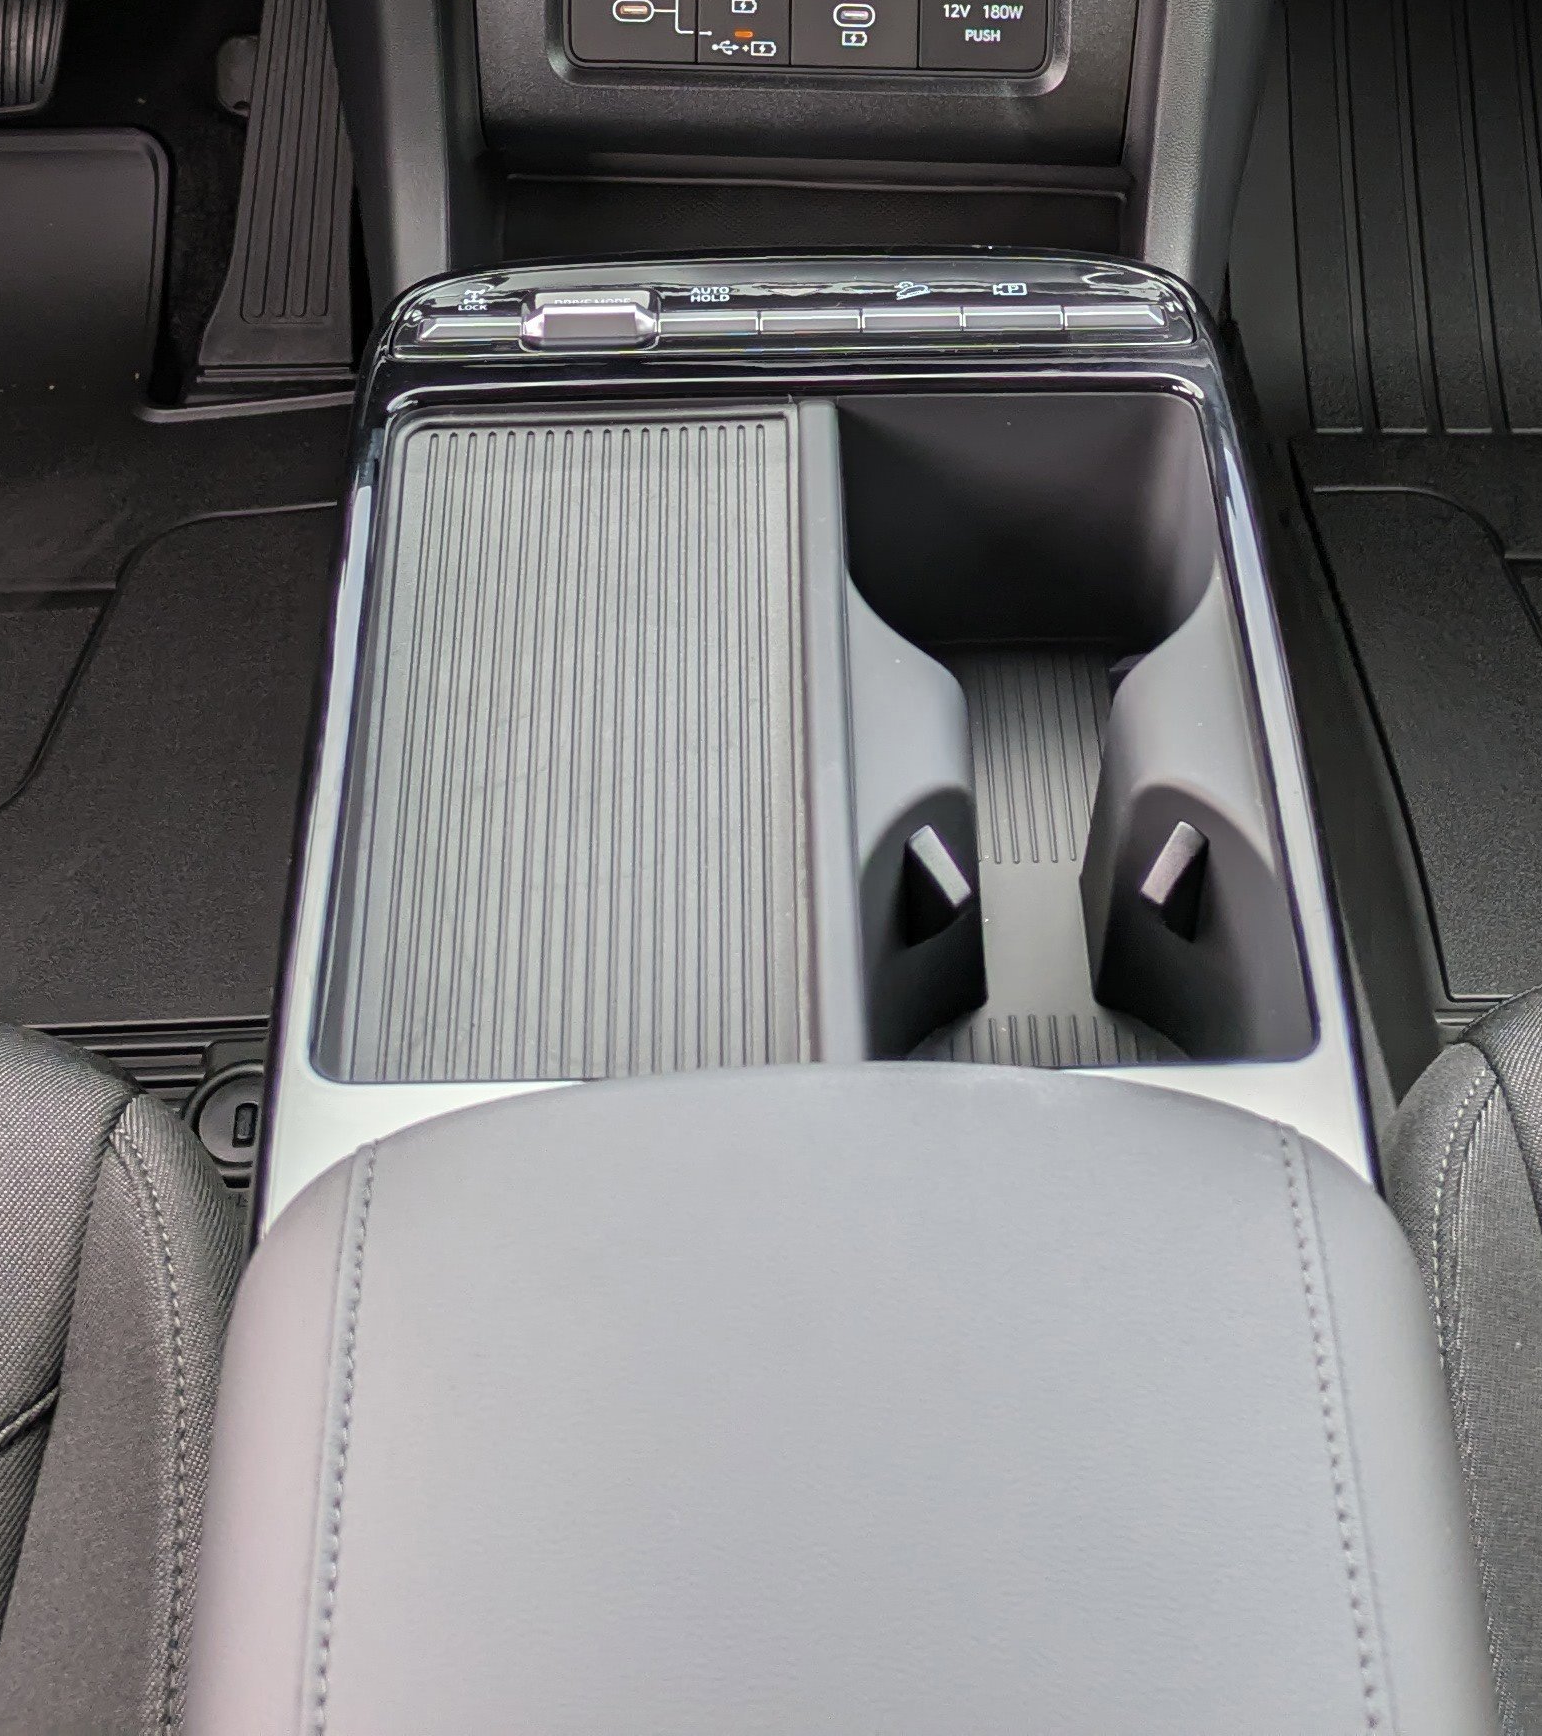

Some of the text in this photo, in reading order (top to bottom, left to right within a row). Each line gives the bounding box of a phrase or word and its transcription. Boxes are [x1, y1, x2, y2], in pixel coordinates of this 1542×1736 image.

[943, 4, 1024, 21] 12V 180W
[964, 28, 1001, 43] PUSH
[690, 286, 730, 295] AUTO
[690, 294, 730, 303] HOLD
